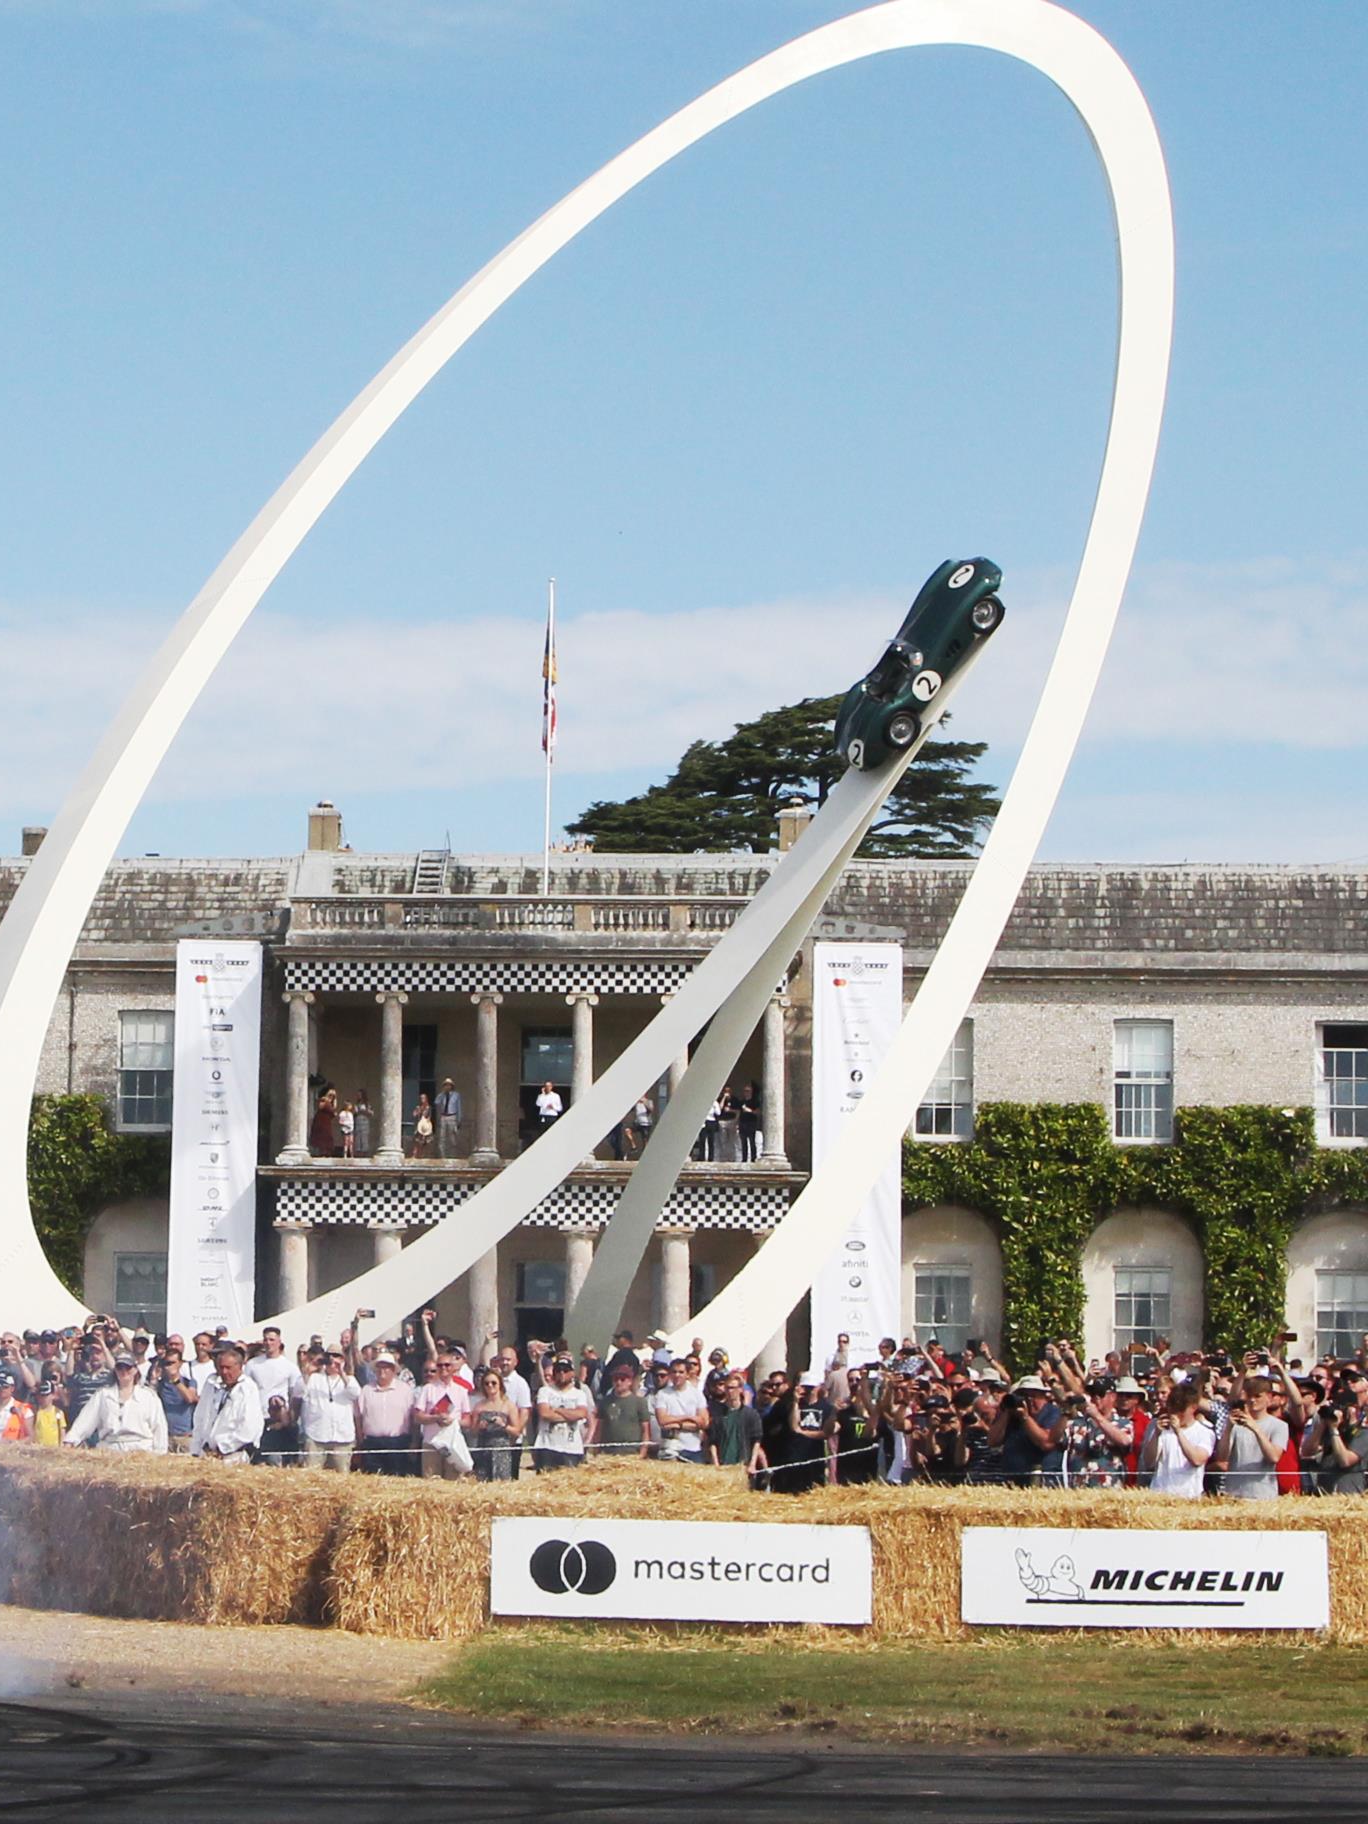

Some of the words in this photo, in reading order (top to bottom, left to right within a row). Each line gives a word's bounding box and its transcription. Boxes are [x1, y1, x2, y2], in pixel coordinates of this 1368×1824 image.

[953, 568, 969, 584] 2
[917, 676, 937, 695] 2
[852, 743, 861, 765] 2
[634, 1556, 830, 1583] mastercard
[1090, 1570, 1284, 1592] MICHELIN
